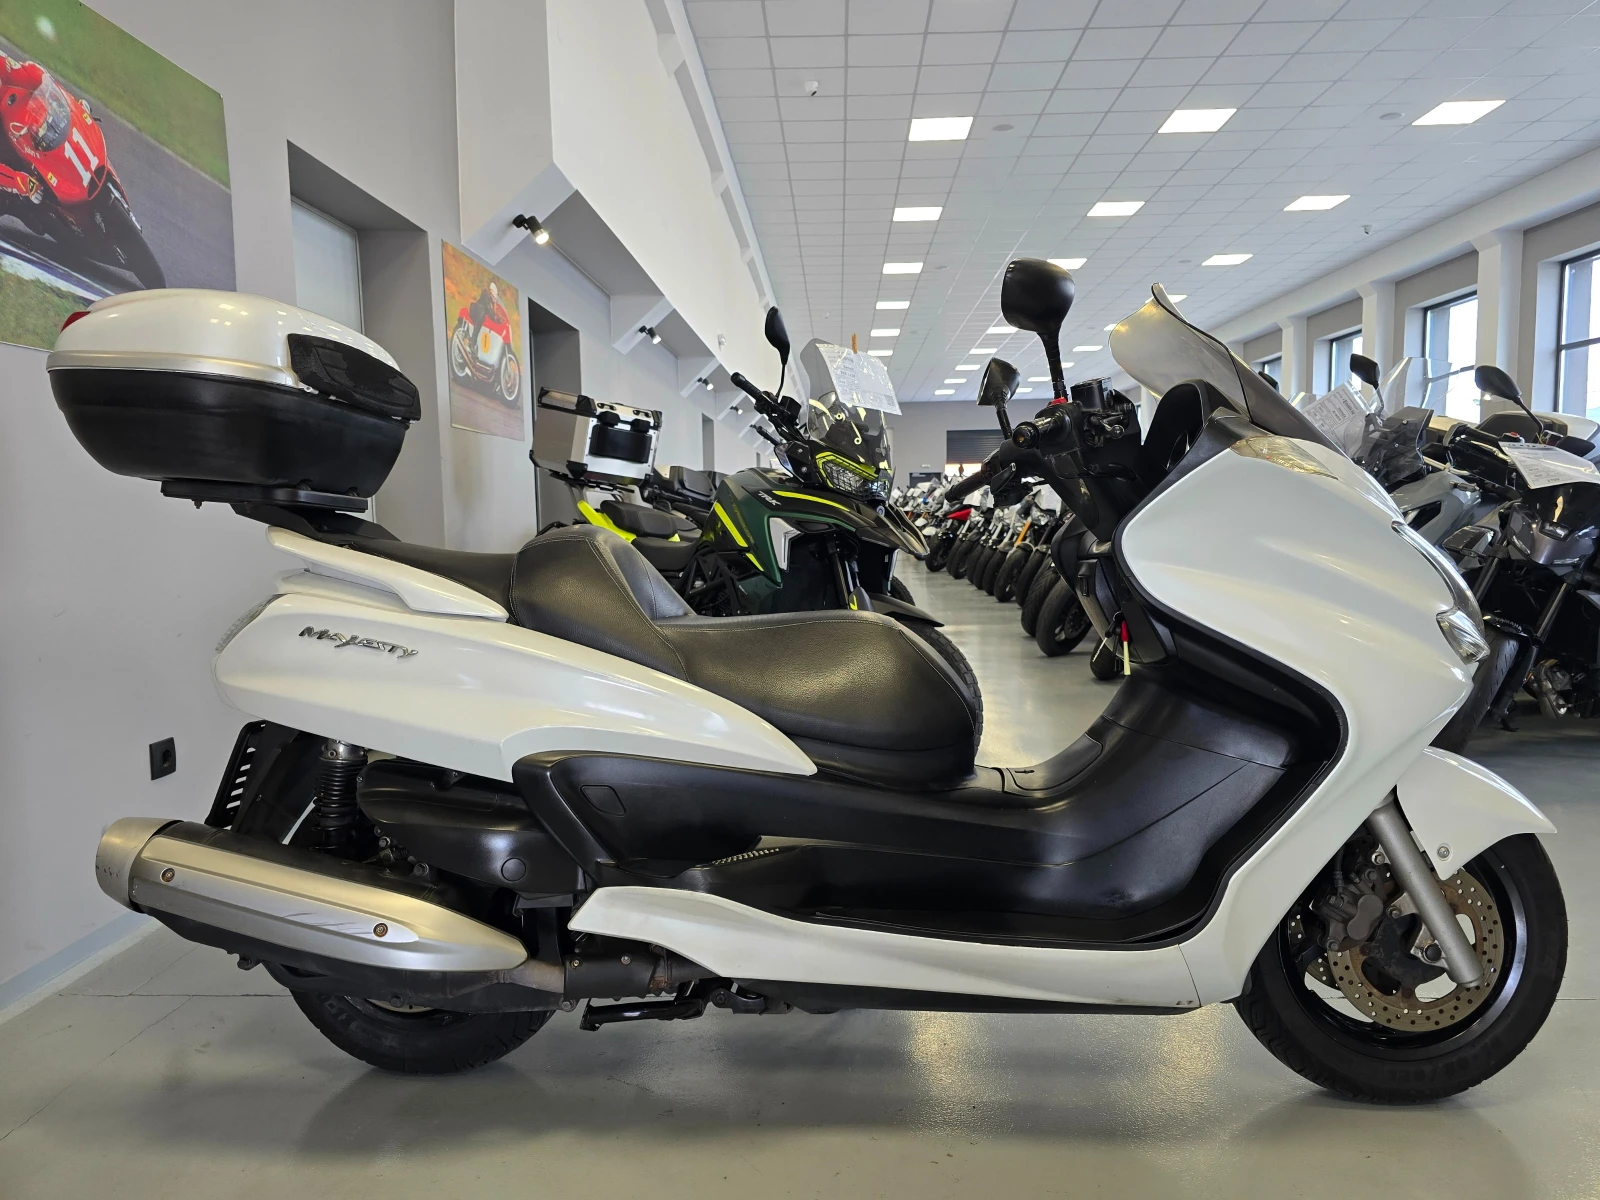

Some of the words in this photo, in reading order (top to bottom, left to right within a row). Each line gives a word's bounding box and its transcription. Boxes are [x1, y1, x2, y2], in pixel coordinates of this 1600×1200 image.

[64, 127, 99, 188] 11
[758, 491, 782, 506] TRK
[298, 626, 418, 659] MAJESTY
